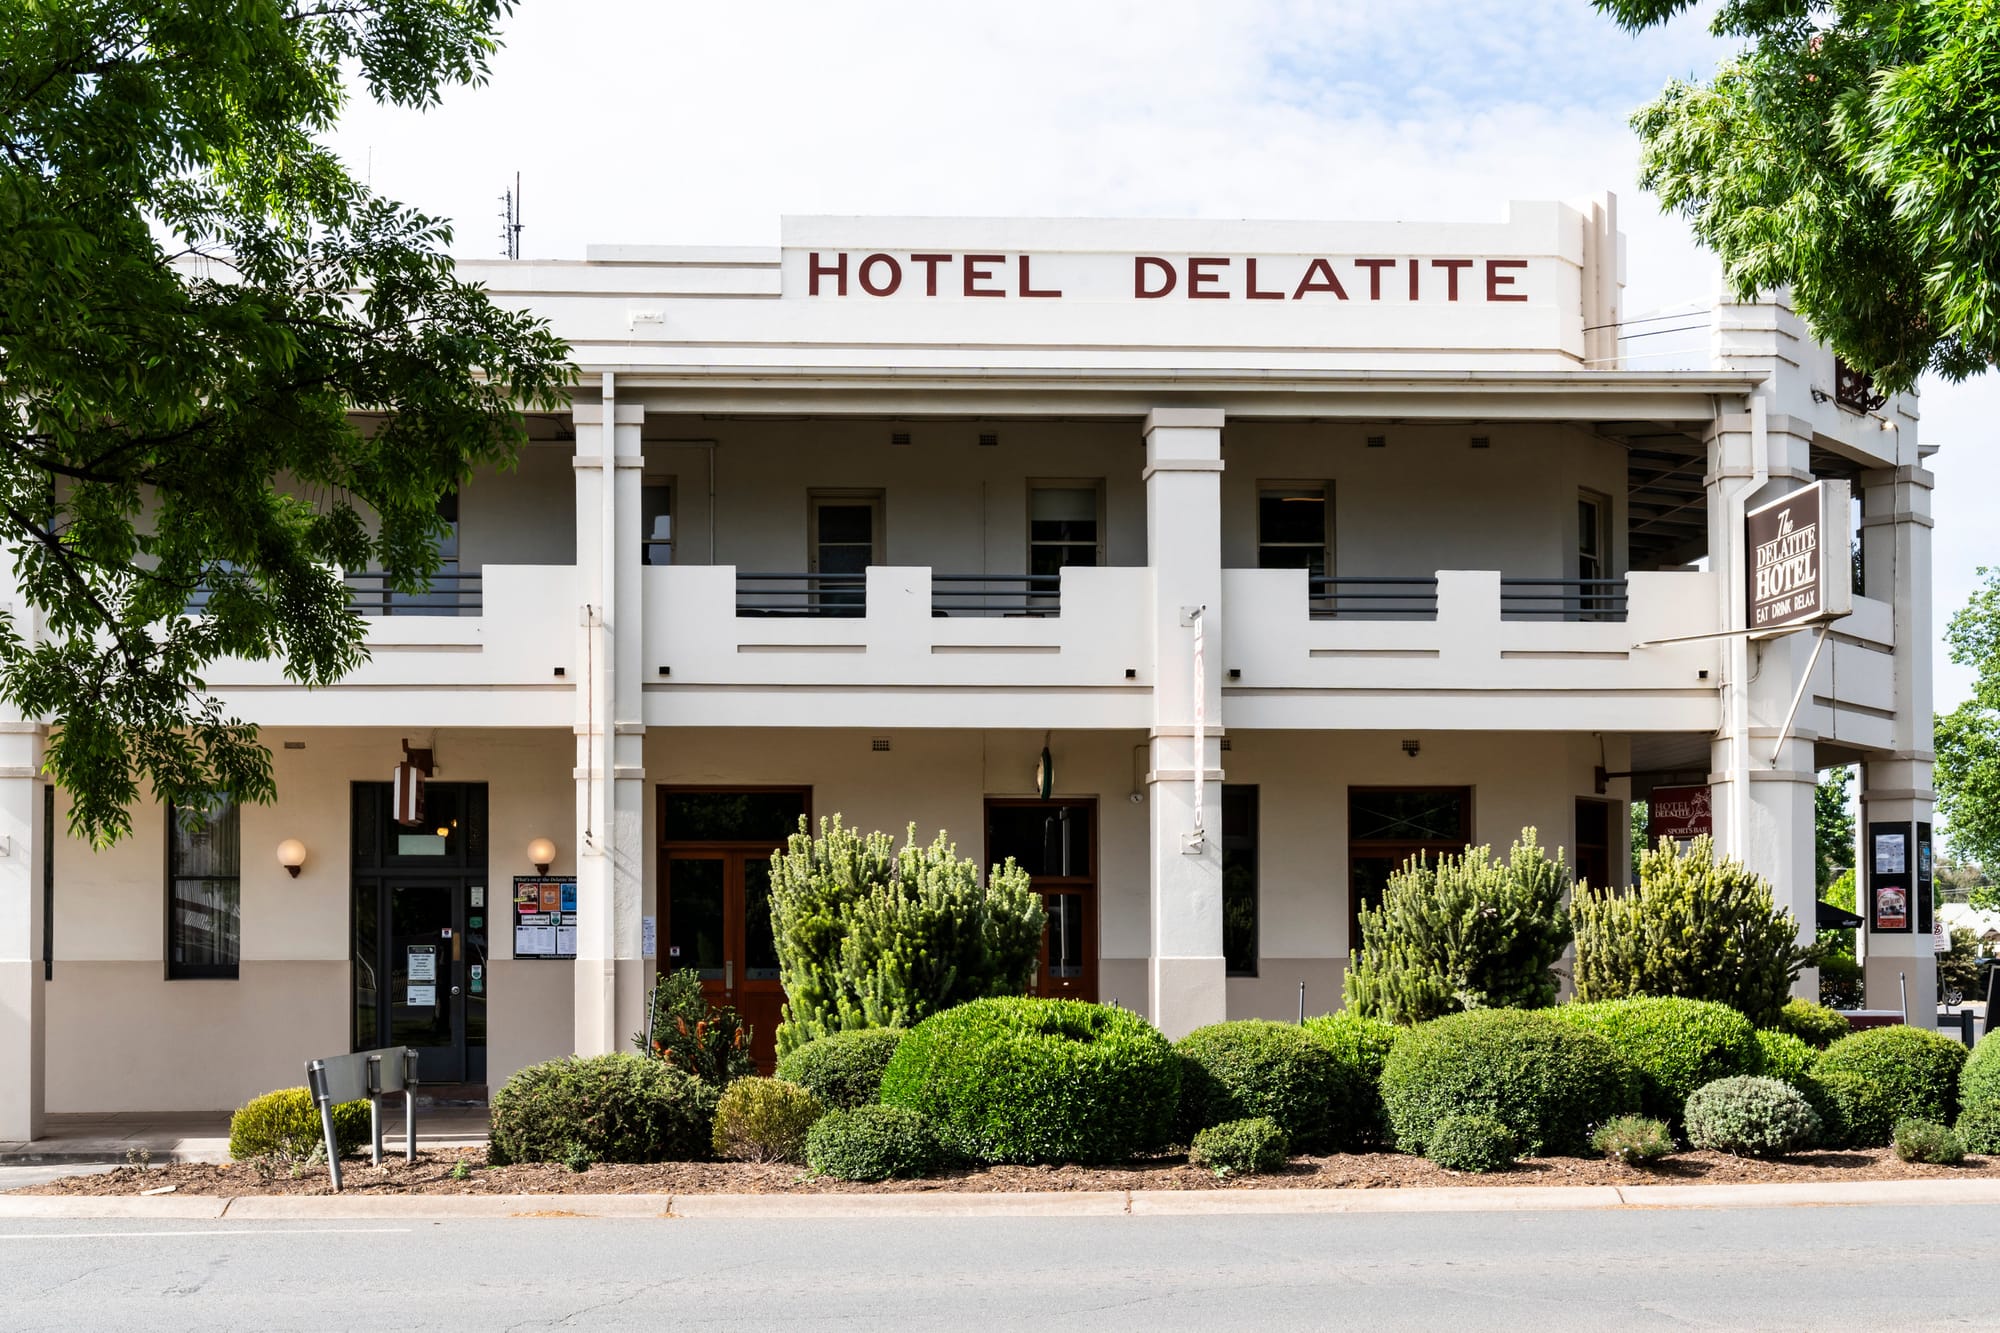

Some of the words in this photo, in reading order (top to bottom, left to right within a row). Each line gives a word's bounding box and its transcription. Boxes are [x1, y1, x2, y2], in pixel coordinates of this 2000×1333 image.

[808, 252, 1063, 298] HOTEL
[1134, 256, 1529, 302] DELATITE
[1777, 508, 1793, 541] The
[1756, 525, 1816, 569] DELATITE
[1756, 552, 1816, 601] HOTEL
[1756, 606, 1769, 624] EAT
[1771, 599, 1792, 619] DRINK
[1794, 590, 1816, 612] RELAX
[1655, 802, 1690, 811] HOTEL
